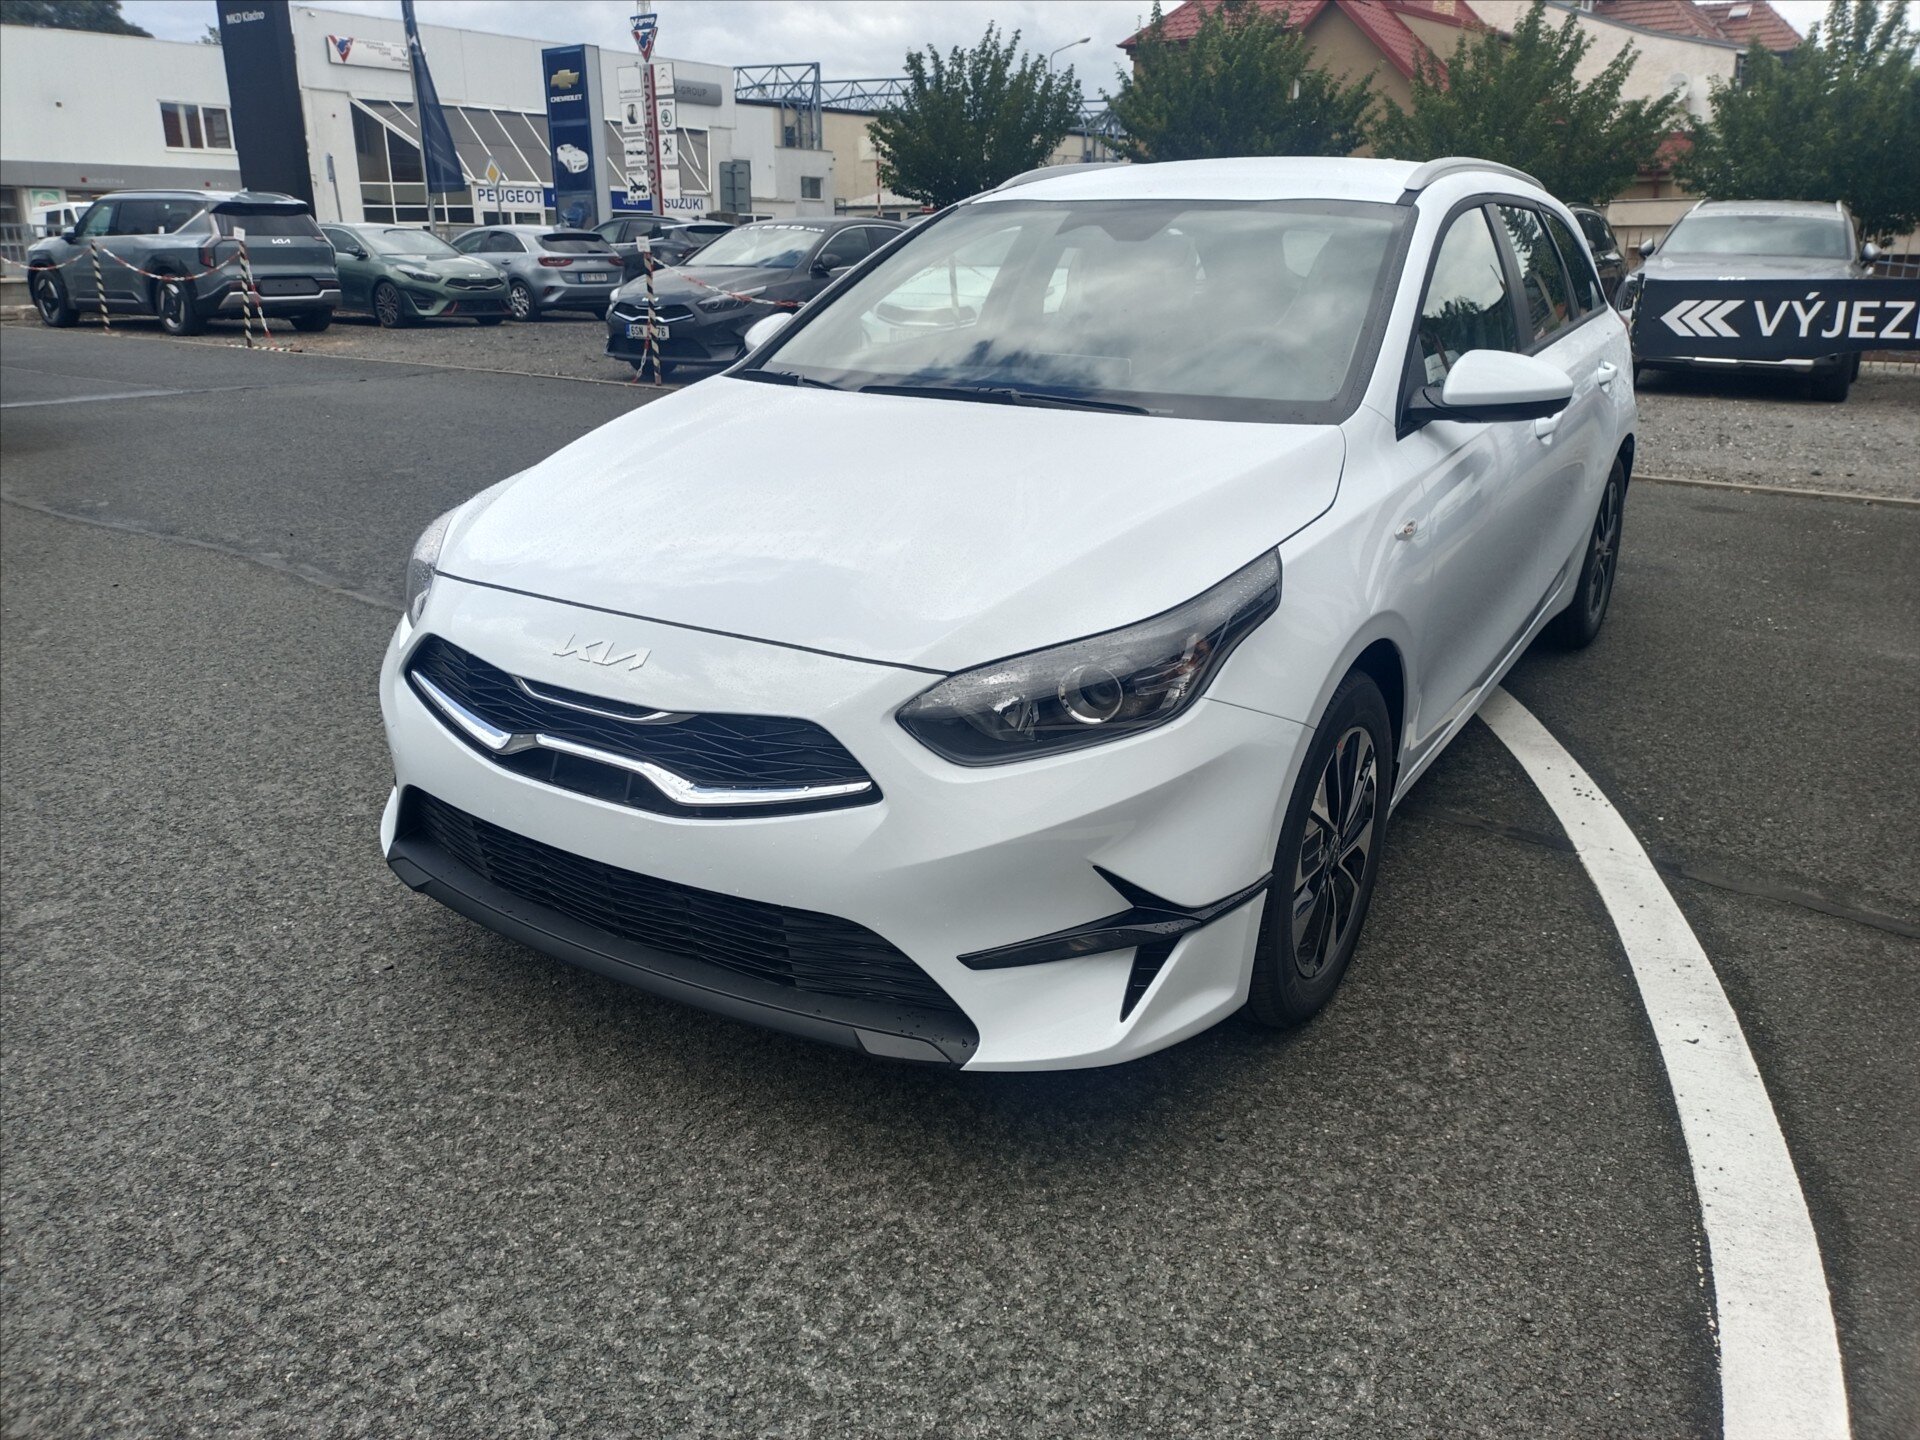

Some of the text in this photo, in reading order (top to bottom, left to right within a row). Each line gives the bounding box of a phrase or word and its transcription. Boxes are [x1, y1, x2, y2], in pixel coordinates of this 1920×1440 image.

[643, 71, 657, 195] AUTOSERVIS
[477, 188, 543, 203] PEUGEOT
[664, 197, 704, 210] SUZUKI
[1754, 291, 1920, 339] VÝJEZ
[552, 632, 651, 671] KIA
